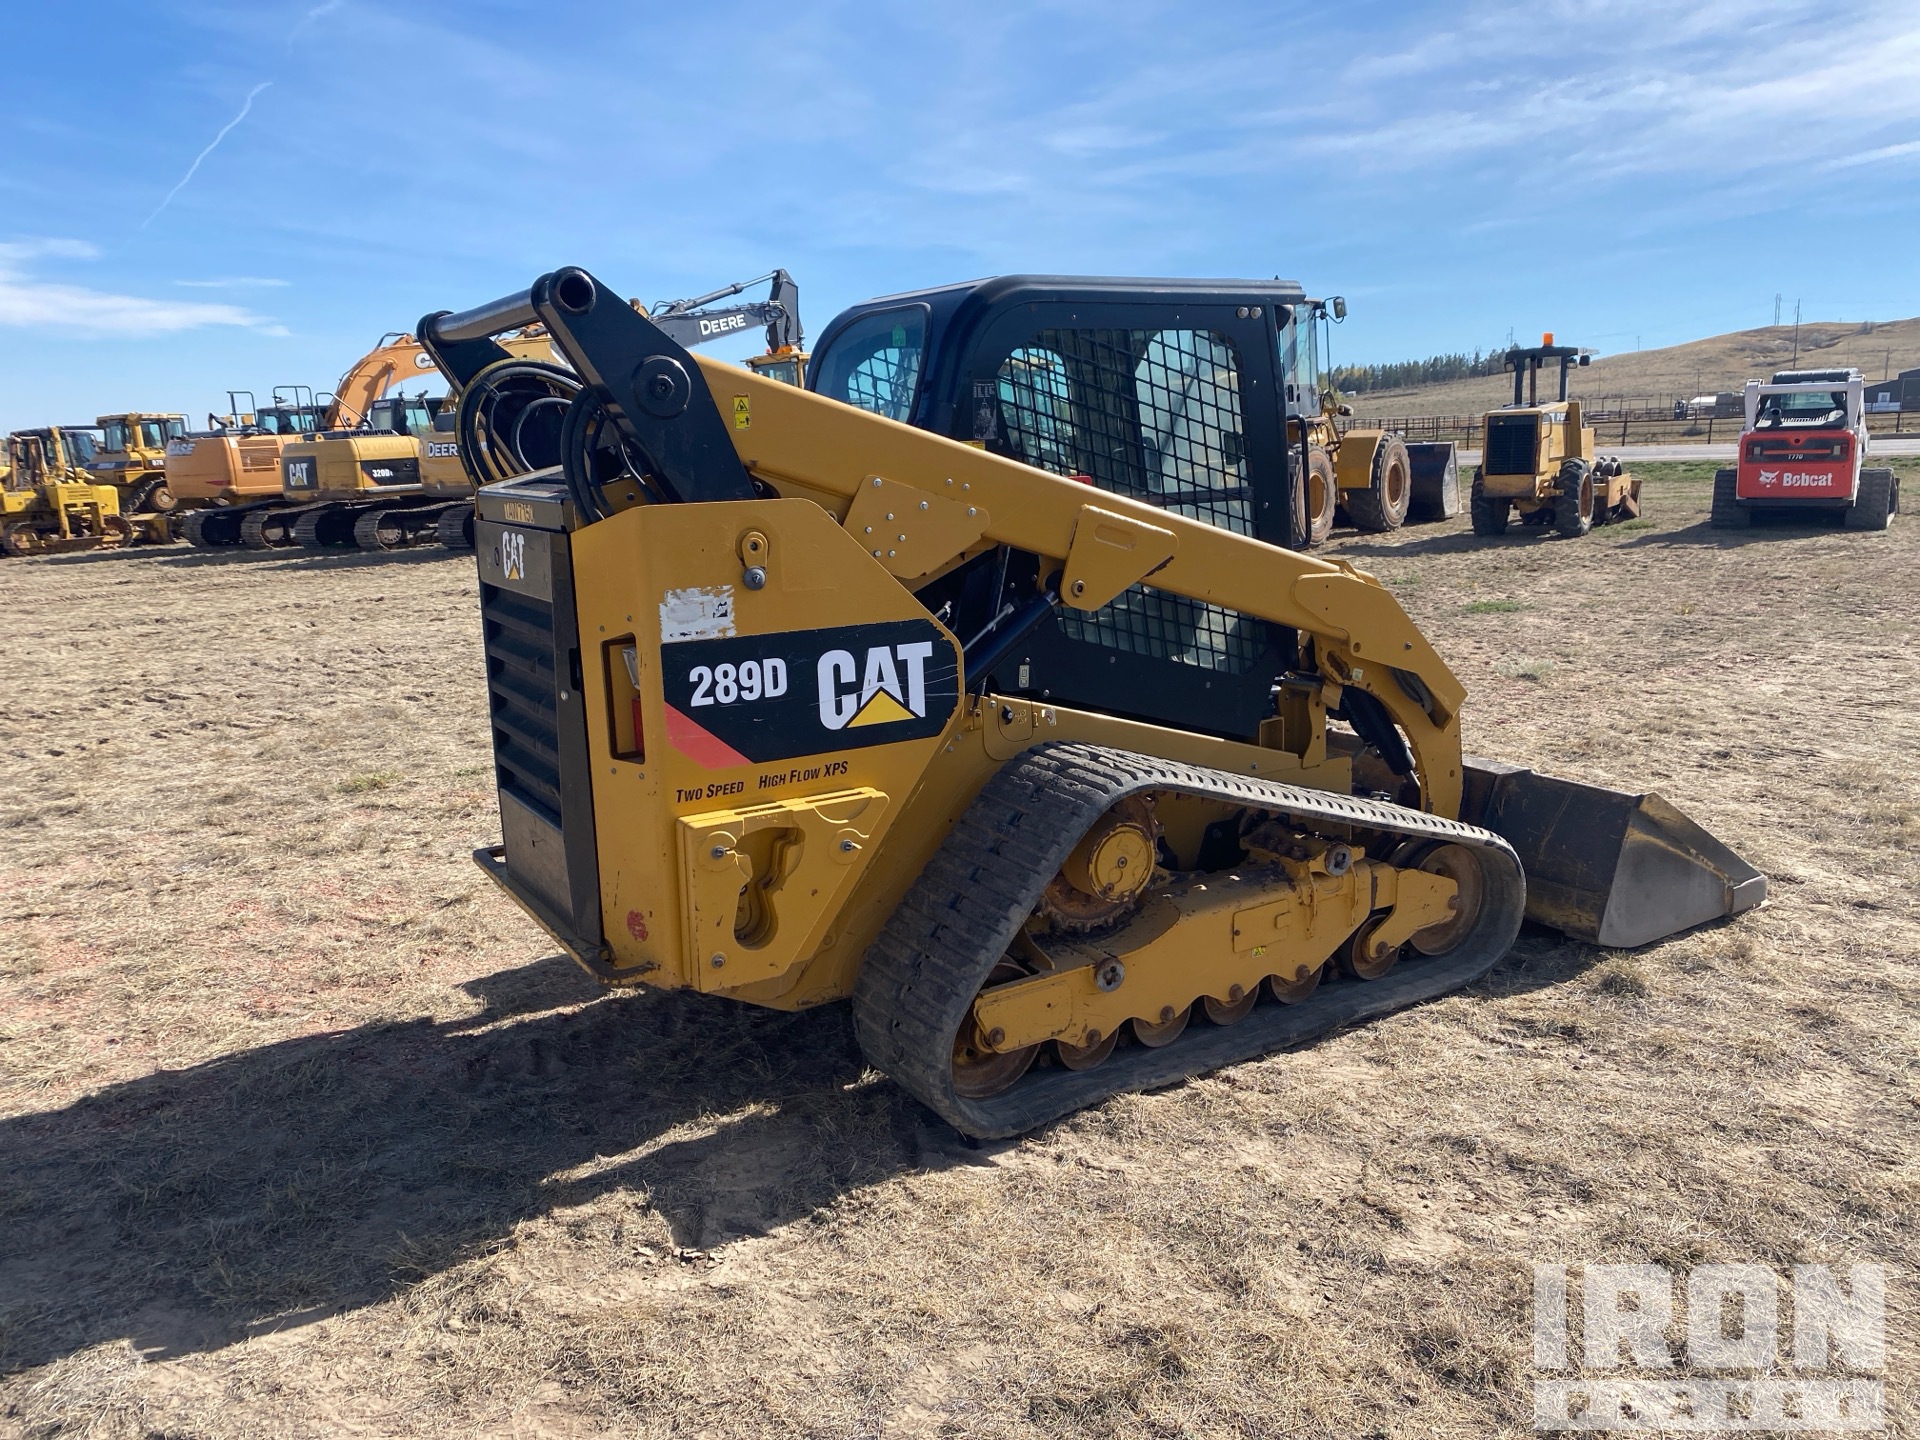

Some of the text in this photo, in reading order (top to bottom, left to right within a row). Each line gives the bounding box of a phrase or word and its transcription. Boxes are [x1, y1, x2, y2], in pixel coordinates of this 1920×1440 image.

[700, 314, 747, 336] DEERE
[427, 442, 459, 457] DEER
[289, 462, 308, 486] CAT
[1782, 472, 1833, 487] Bobcat
[502, 531, 525, 580] CAT
[689, 657, 788, 707] 289D
[817, 641, 933, 730] CAT
[758, 760, 849, 789] HIGH FLOW XPS
[676, 781, 745, 803] TWO SPEED
